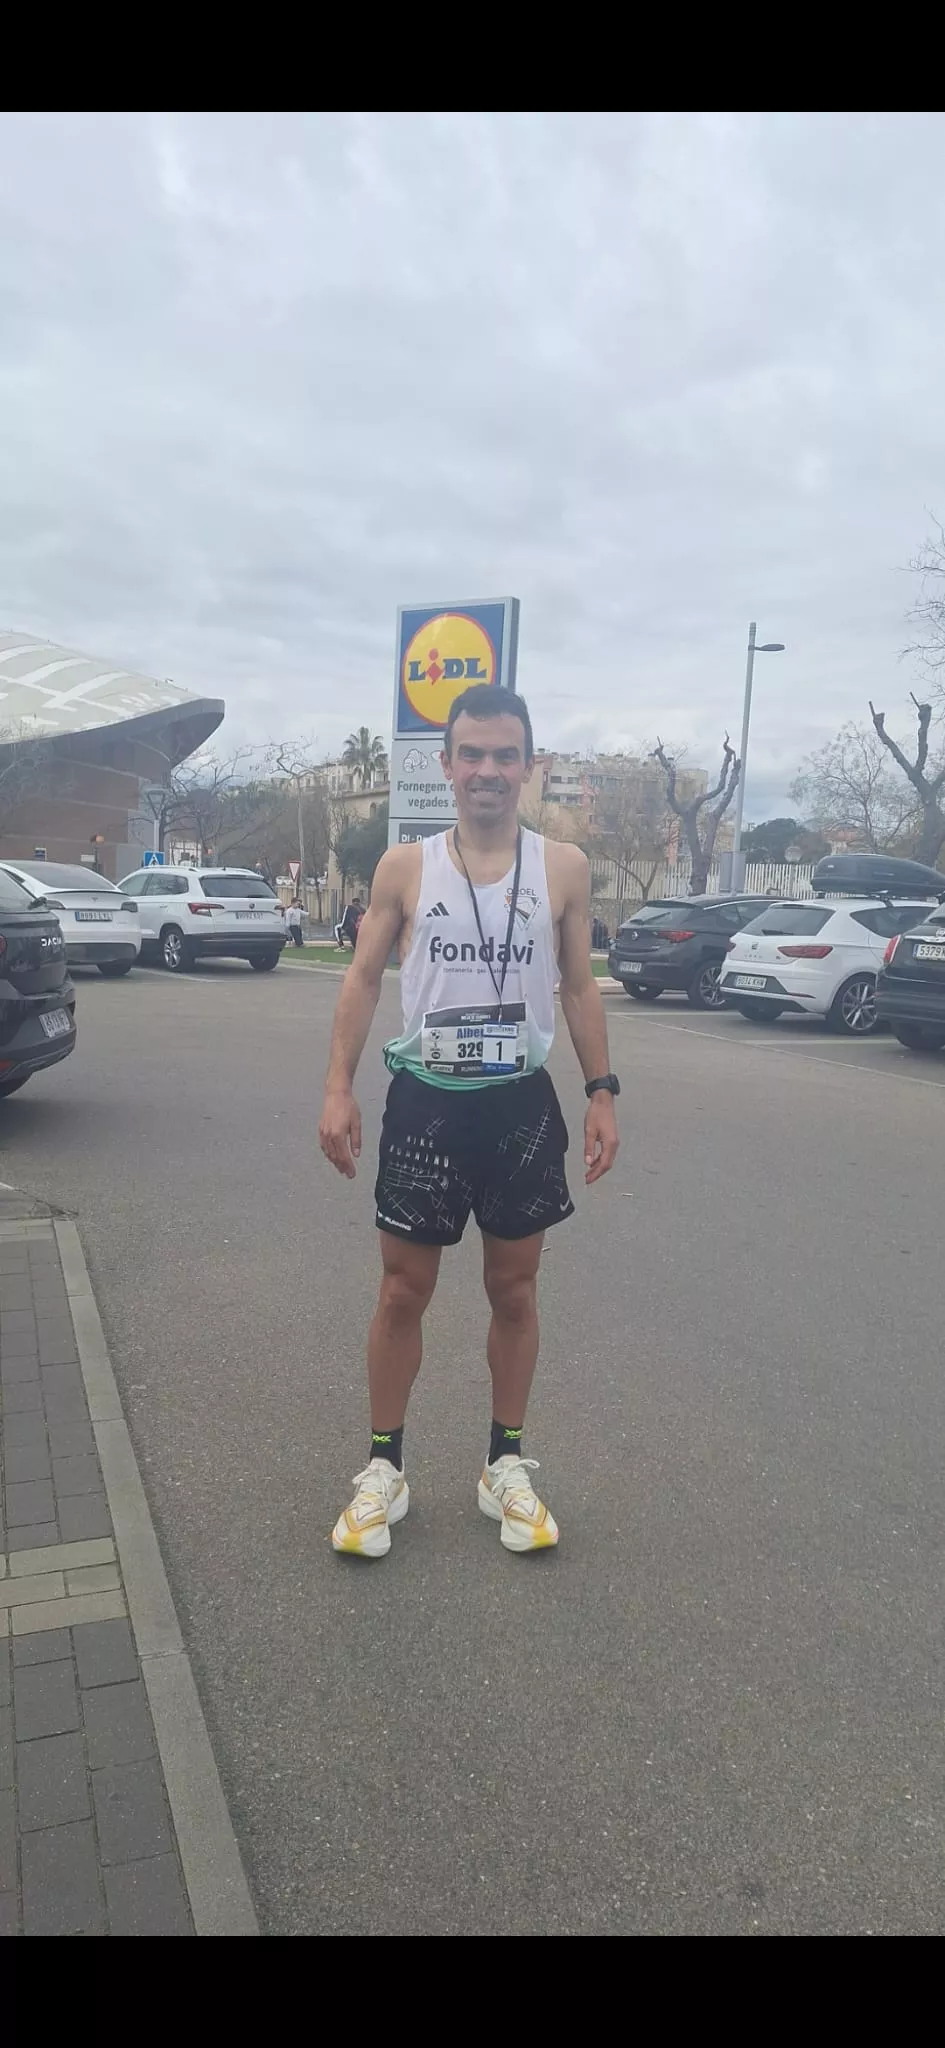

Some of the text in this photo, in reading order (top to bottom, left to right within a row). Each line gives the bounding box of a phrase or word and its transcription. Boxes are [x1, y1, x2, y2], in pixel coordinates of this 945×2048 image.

[397, 781, 447, 794] Fornegem
[408, 796, 449, 810] vegades
[507, 887, 537, 896] OOEL
[429, 936, 534, 965] fondavi
[495, 1041, 503, 1061] 1
